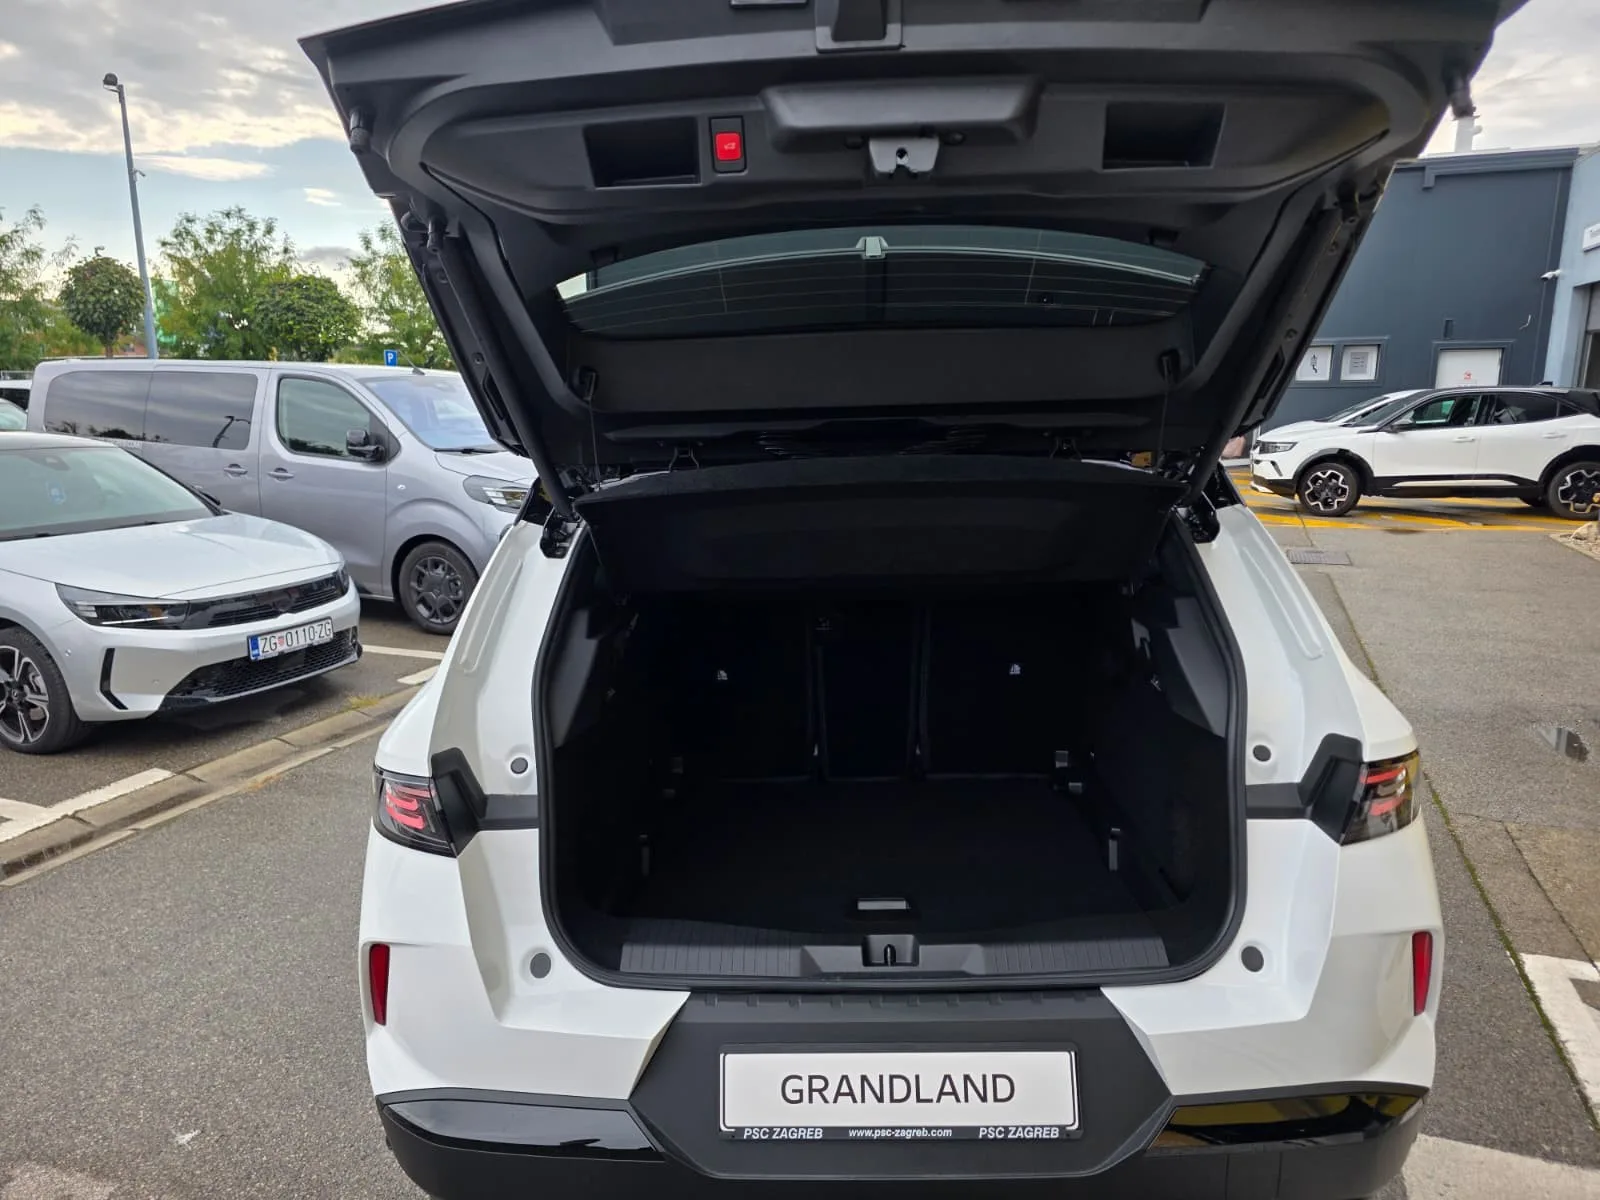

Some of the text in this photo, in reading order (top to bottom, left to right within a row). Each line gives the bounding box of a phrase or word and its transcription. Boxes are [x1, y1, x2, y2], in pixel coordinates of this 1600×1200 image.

[387, 352, 394, 364] P
[261, 635, 278, 654] ZG
[780, 1073, 1016, 1105] GRANDLAND
[743, 1128, 823, 1140] PSC ZAGREB
[848, 1127, 952, 1139] www.psc-zagreb.com
[978, 1127, 1059, 1139] PSC ZAGREB
